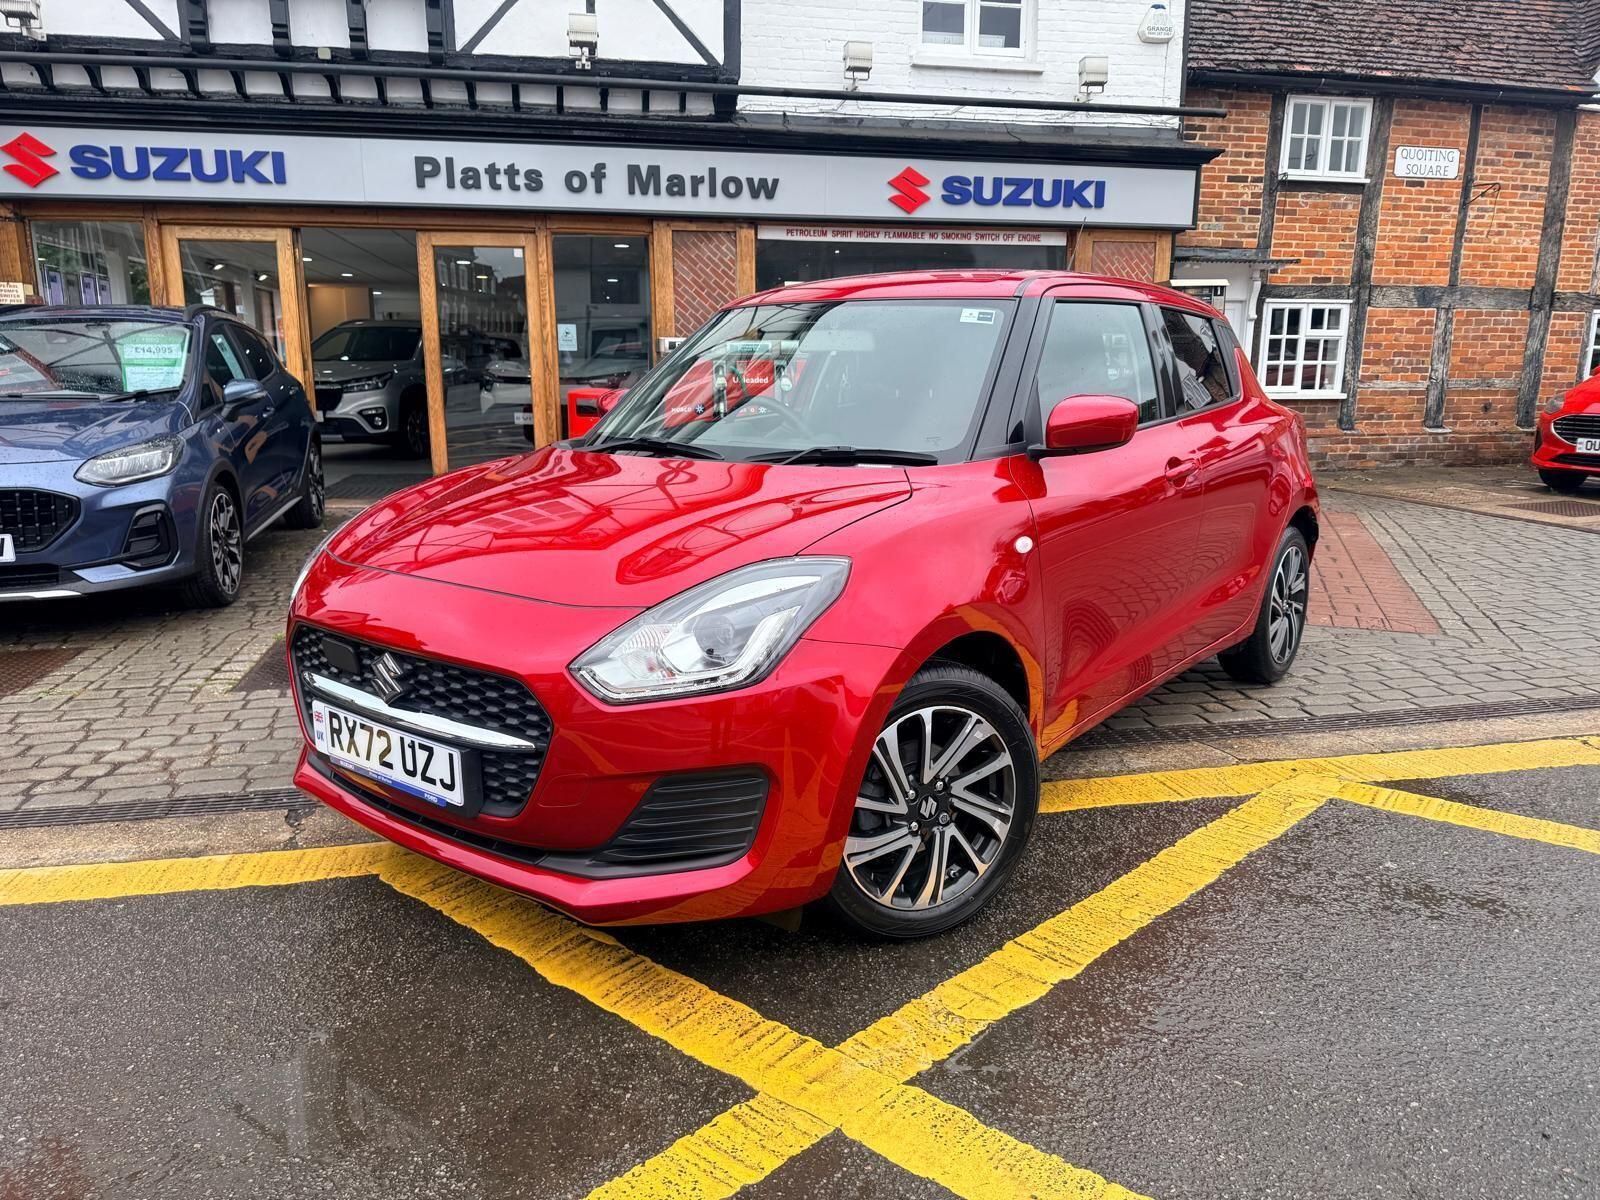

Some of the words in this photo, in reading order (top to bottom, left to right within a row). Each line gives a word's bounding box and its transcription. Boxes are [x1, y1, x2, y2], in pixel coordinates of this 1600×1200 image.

[1401, 148, 1454, 162] QUOITING
[69, 144, 287, 185] SUZUKI
[1406, 164, 1449, 176] SQUARE
[414, 155, 543, 192] Platts
[564, 162, 606, 194] of
[626, 163, 780, 200] Marlow
[941, 175, 1106, 209] SUZUKI
[786, 228, 828, 238] PETROLEUM
[831, 230, 853, 239] SPIRIT
[856, 230, 880, 239] HIGHLY
[884, 231, 925, 240] FLAMMABLE
[929, 231, 939, 240] NO
[941, 231, 972, 241] SMOKING
[975, 232, 1000, 242] SWITCH
[1002, 233, 1015, 242] OFF
[1018, 233, 1042, 243] ENGINE
[135, 345, 173, 354] £14,995
[732, 376, 769, 384] Uleaded
[316, 730, 324, 741] UK
[328, 710, 394, 771] RX72
[400, 736, 456, 792] UZJ
